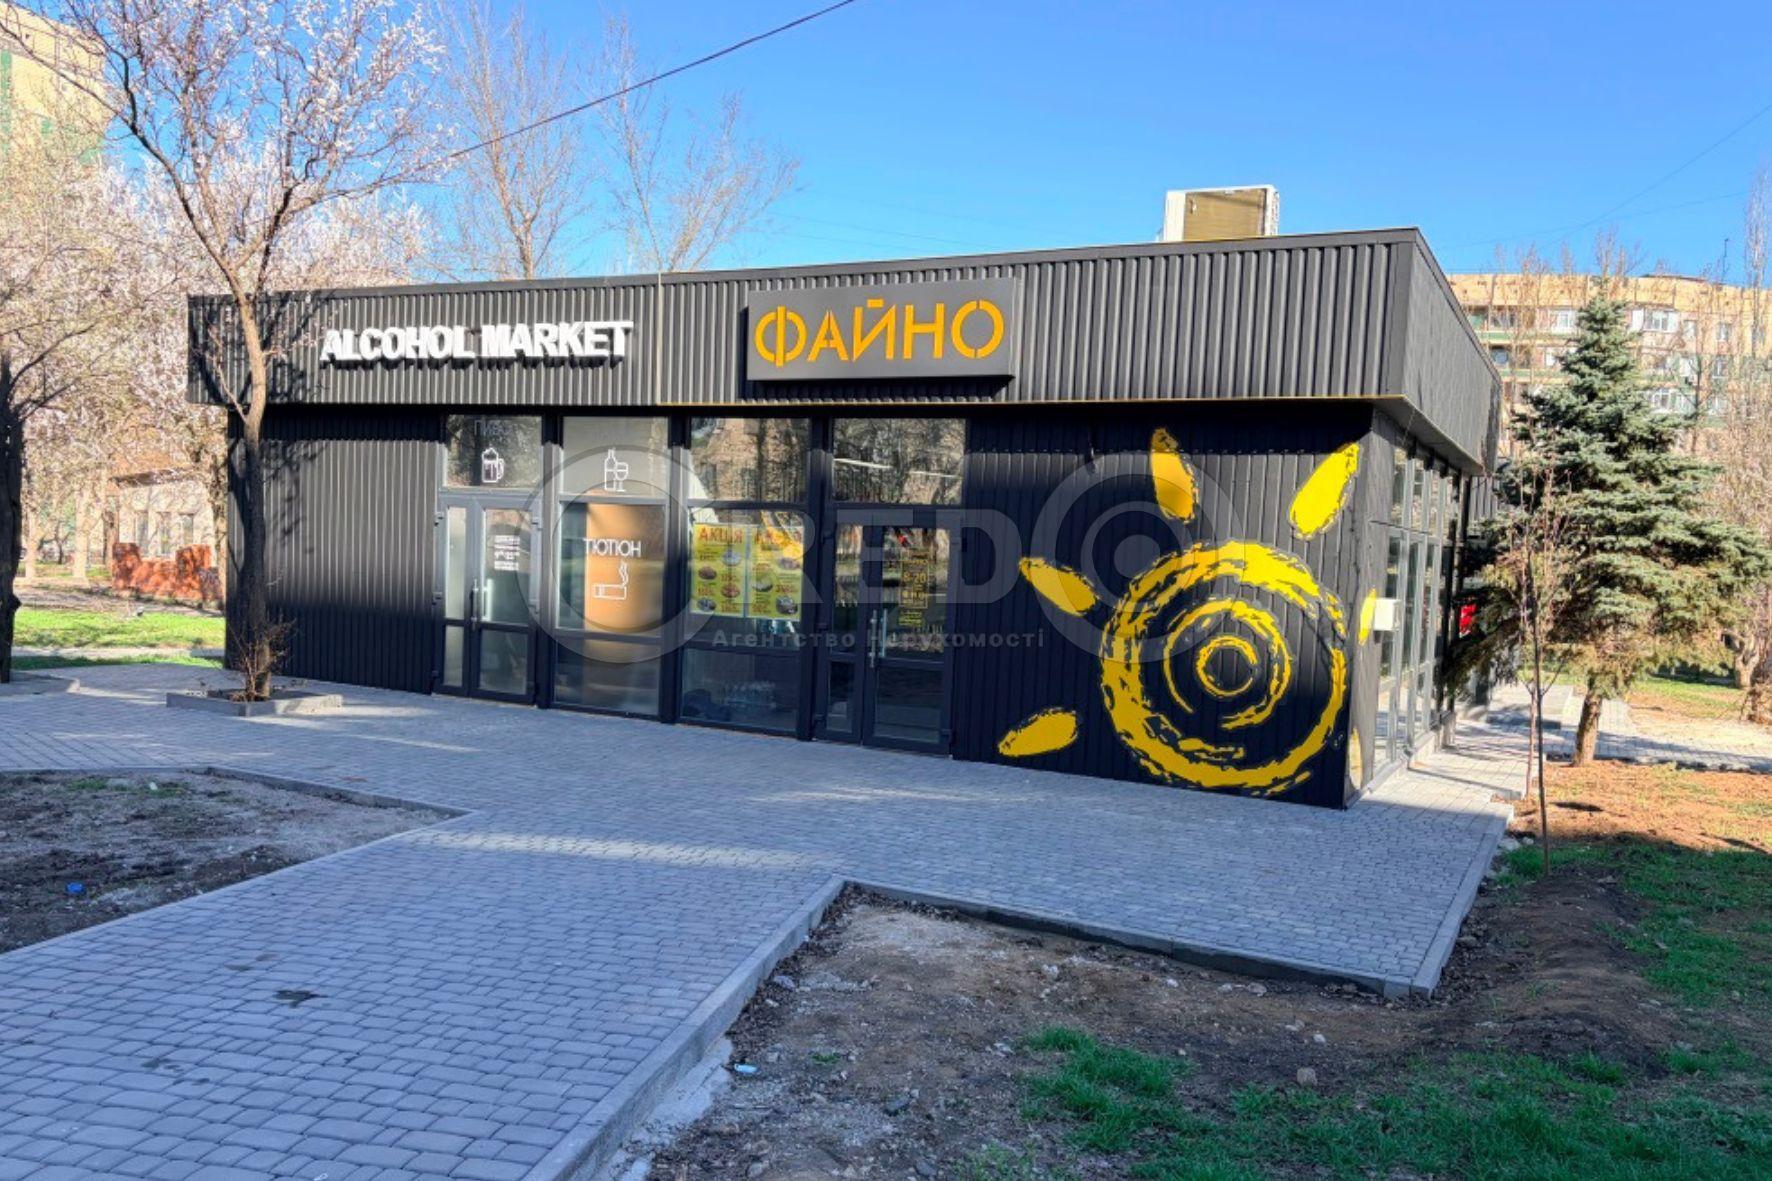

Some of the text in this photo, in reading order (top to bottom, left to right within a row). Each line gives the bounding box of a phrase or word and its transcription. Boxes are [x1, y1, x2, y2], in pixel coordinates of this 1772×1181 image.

[319, 320, 634, 362] ALCOHOL MARKET
[754, 298, 1005, 367] ФАЙНО
[583, 538, 642, 557] ТЮТЮН
